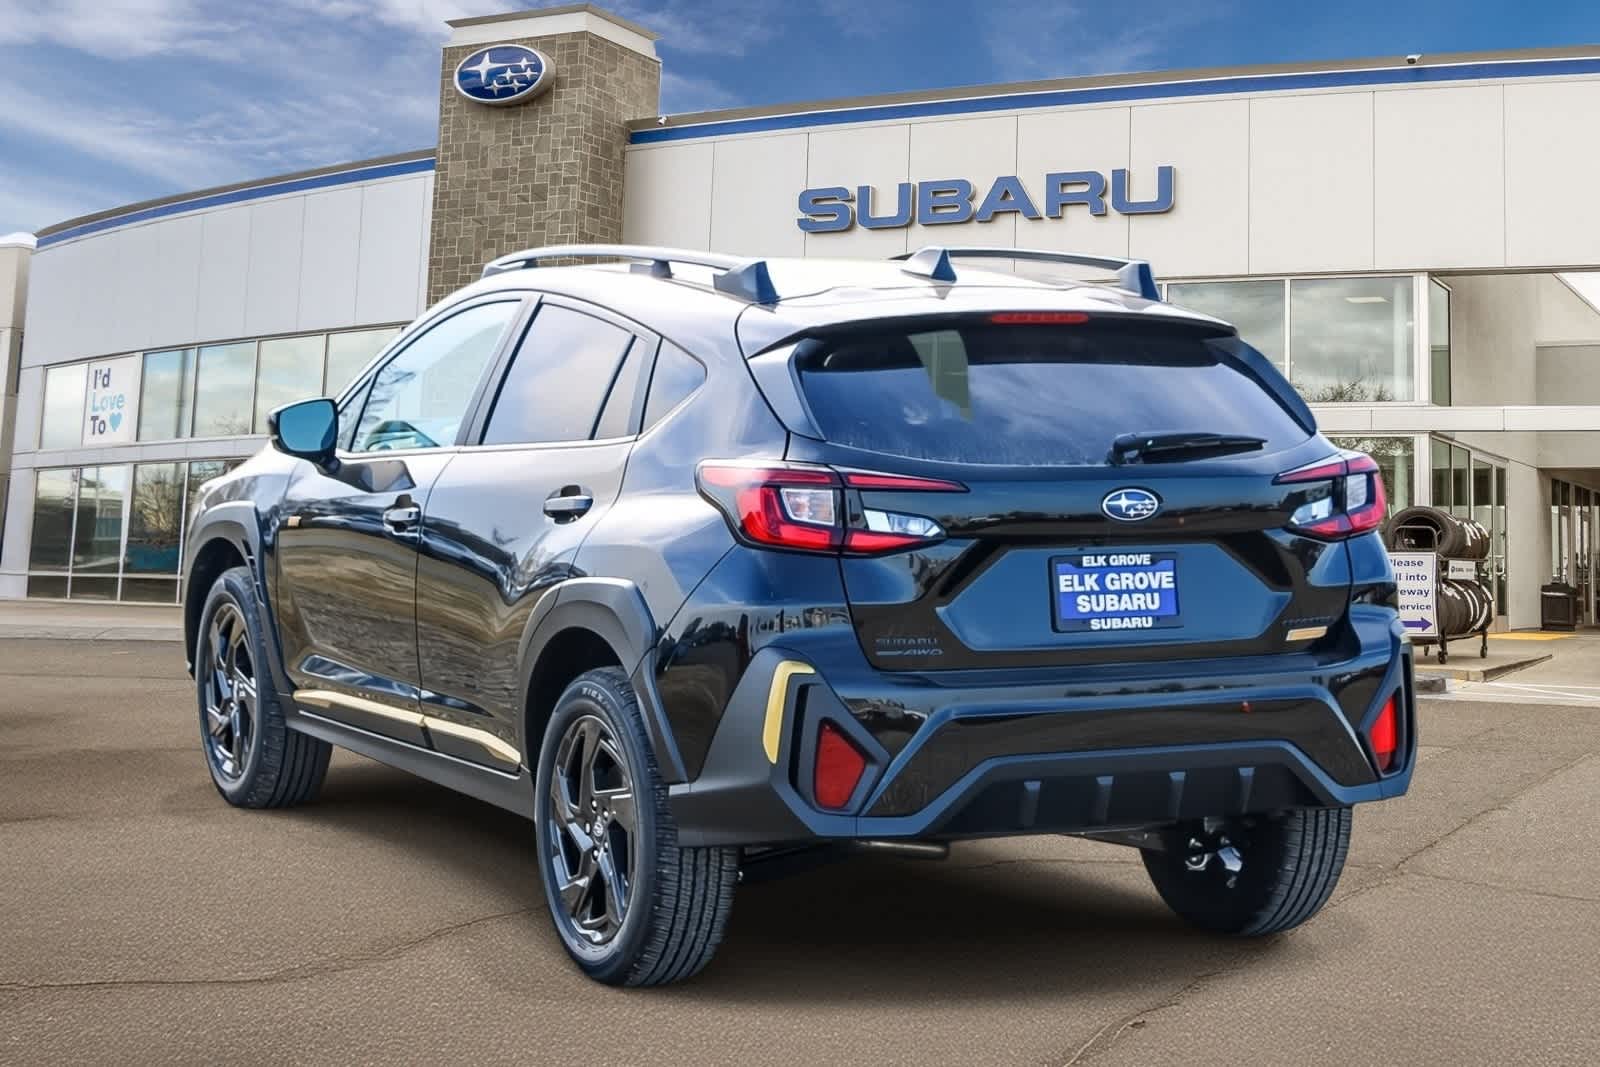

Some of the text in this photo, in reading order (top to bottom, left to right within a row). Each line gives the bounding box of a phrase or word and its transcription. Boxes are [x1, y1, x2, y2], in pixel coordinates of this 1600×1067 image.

[796, 165, 1174, 233] SUBARU
[93, 367, 111, 389] I'd
[91, 392, 125, 412] Love
[90, 415, 106, 435] To
[1082, 554, 1152, 567] ELK GROVE
[1389, 559, 1424, 567] lease
[1059, 571, 1175, 593] ELK GROVE
[1405, 573, 1428, 581] into
[1076, 592, 1160, 613] SUBARU
[1090, 616, 1153, 630] SUBARU
